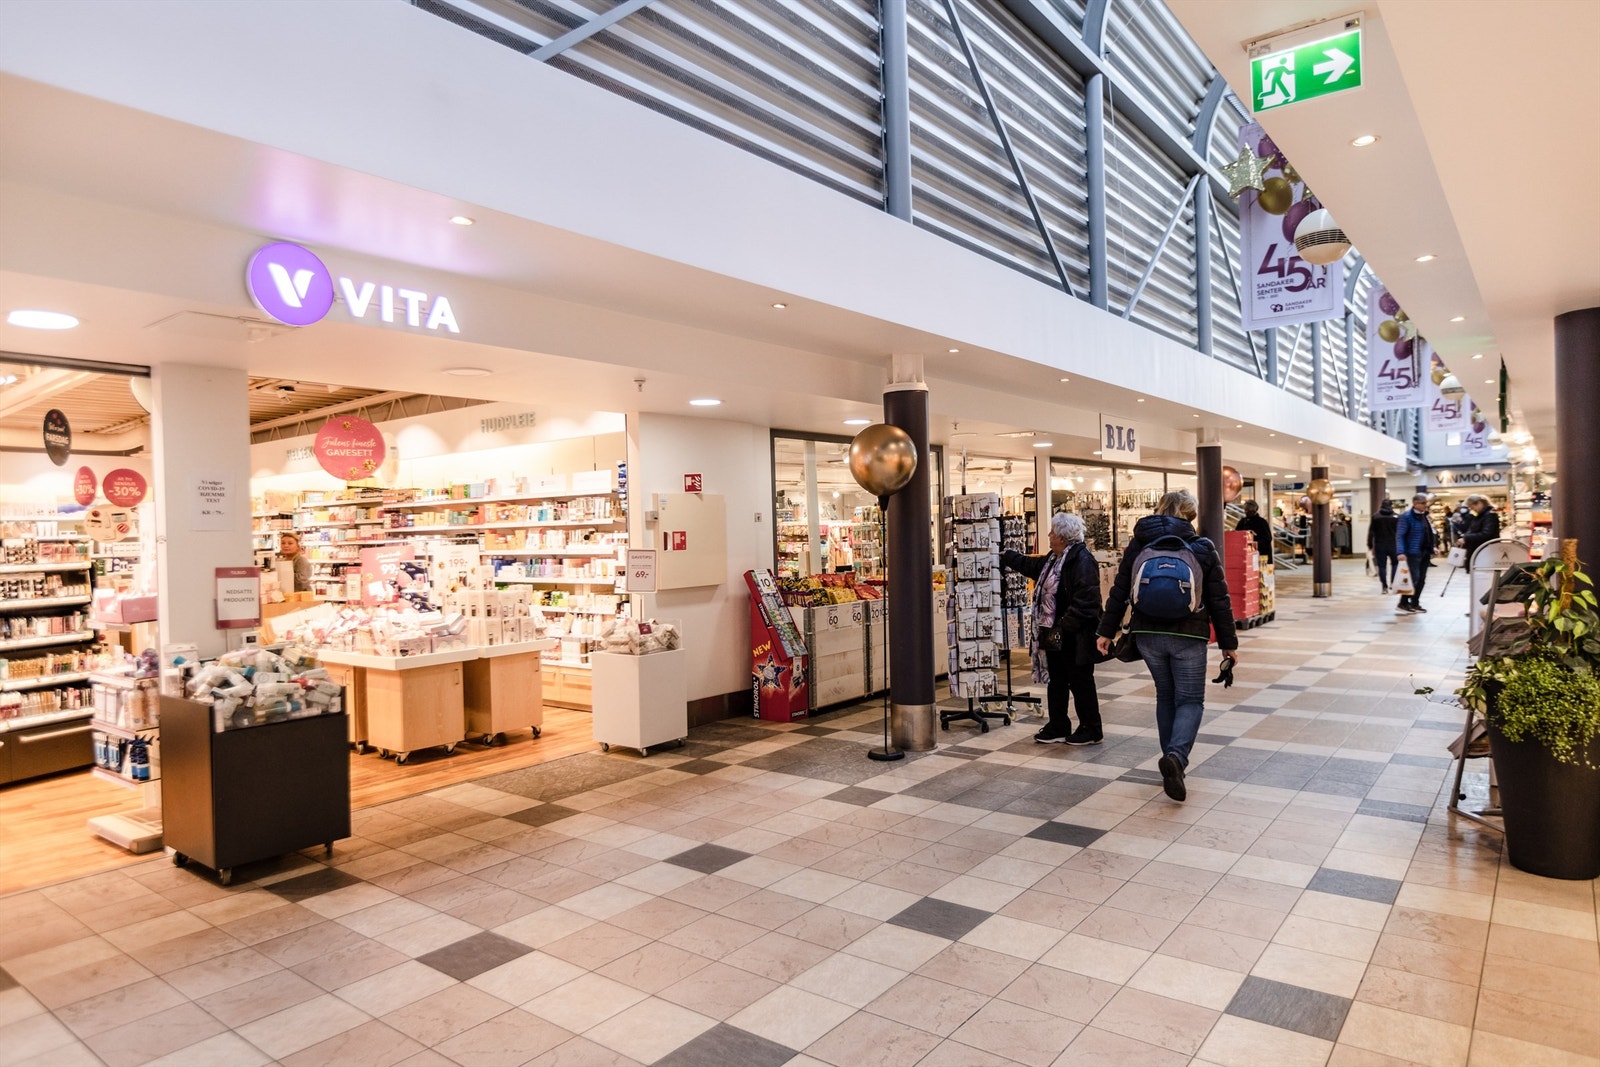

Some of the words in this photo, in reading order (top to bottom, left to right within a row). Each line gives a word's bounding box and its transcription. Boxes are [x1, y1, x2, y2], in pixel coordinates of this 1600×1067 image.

[1257, 243, 1312, 292] 45
[1256, 278, 1294, 290] SANDAKER
[1257, 287, 1283, 296] SENTER
[339, 277, 460, 333] VITA
[1284, 299, 1312, 307] SANDAKER
[1377, 359, 1411, 389] 45
[1431, 398, 1457, 419] 45
[480, 411, 536, 433] HUDPLEIE
[321, 436, 350, 449] Julens
[1105, 423, 1136, 452] BLG
[1465, 433, 1483, 449] 45
[326, 449, 374, 457] GAVESETT
[108, 487, 141, 496] -30%
[635, 570, 649, 579] 69,-
[760, 578, 771, 587] 10
[828, 615, 838, 625] 60
[852, 612, 862, 621] 60
[753, 640, 771, 657] NEW
